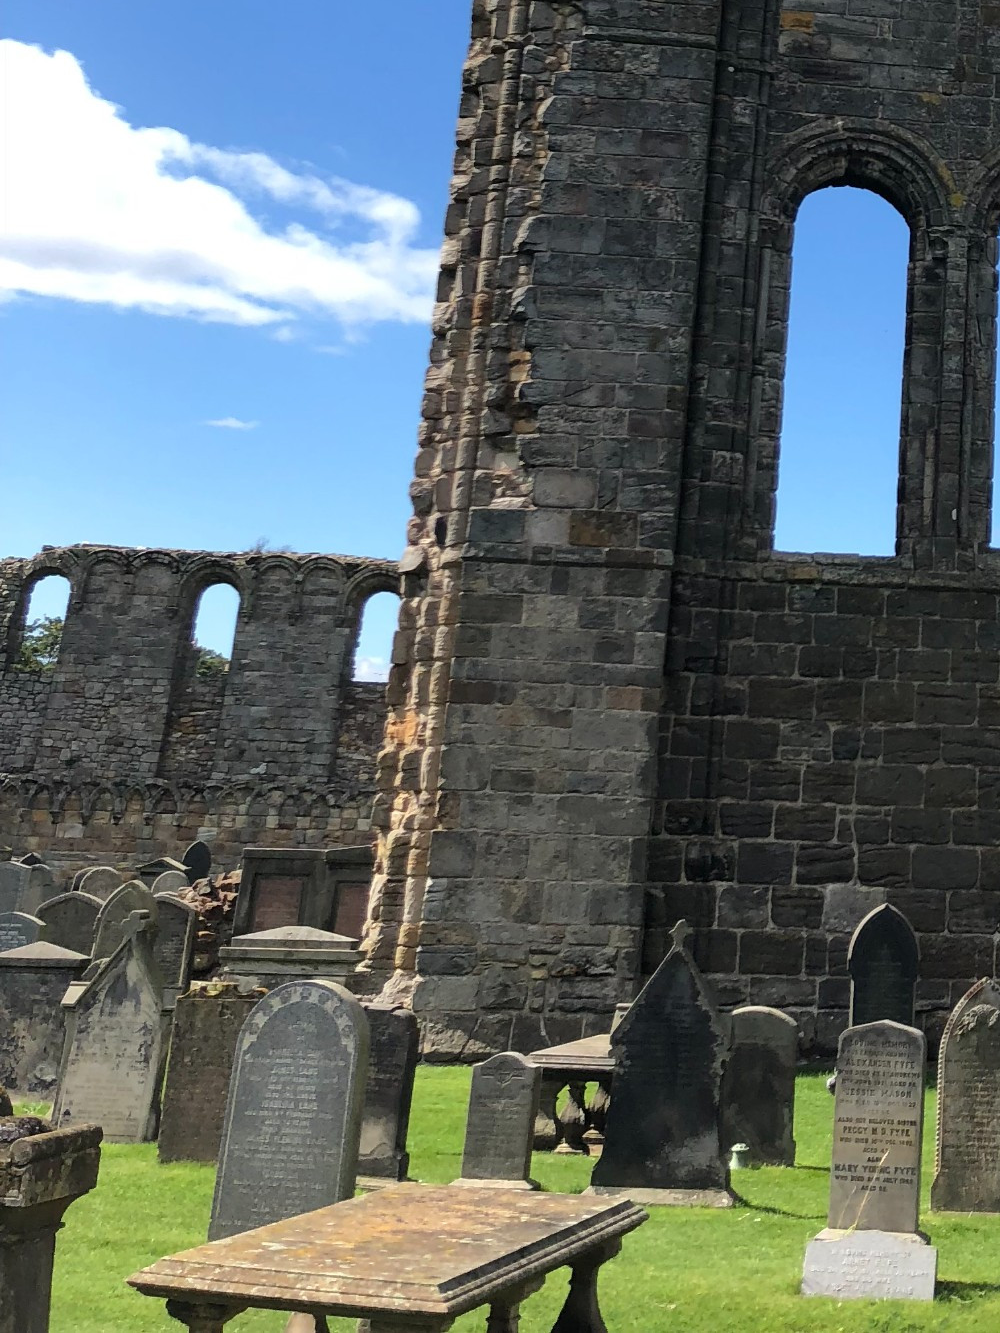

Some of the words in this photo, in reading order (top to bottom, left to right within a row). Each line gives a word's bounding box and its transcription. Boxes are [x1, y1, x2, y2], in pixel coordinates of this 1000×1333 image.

[845, 1058, 892, 1068] ALEXANDER
[894, 1060, 915, 1069] FYFE
[843, 1088, 875, 1097] JESSIE
[881, 1089, 912, 1099] MASON
[843, 1125, 868, 1135] PEGGY
[890, 1129, 911, 1137] FYFE
[834, 1163, 859, 1173] MARY
[861, 1165, 891, 1175] YOUNG
[894, 1167, 917, 1176] FYFE
